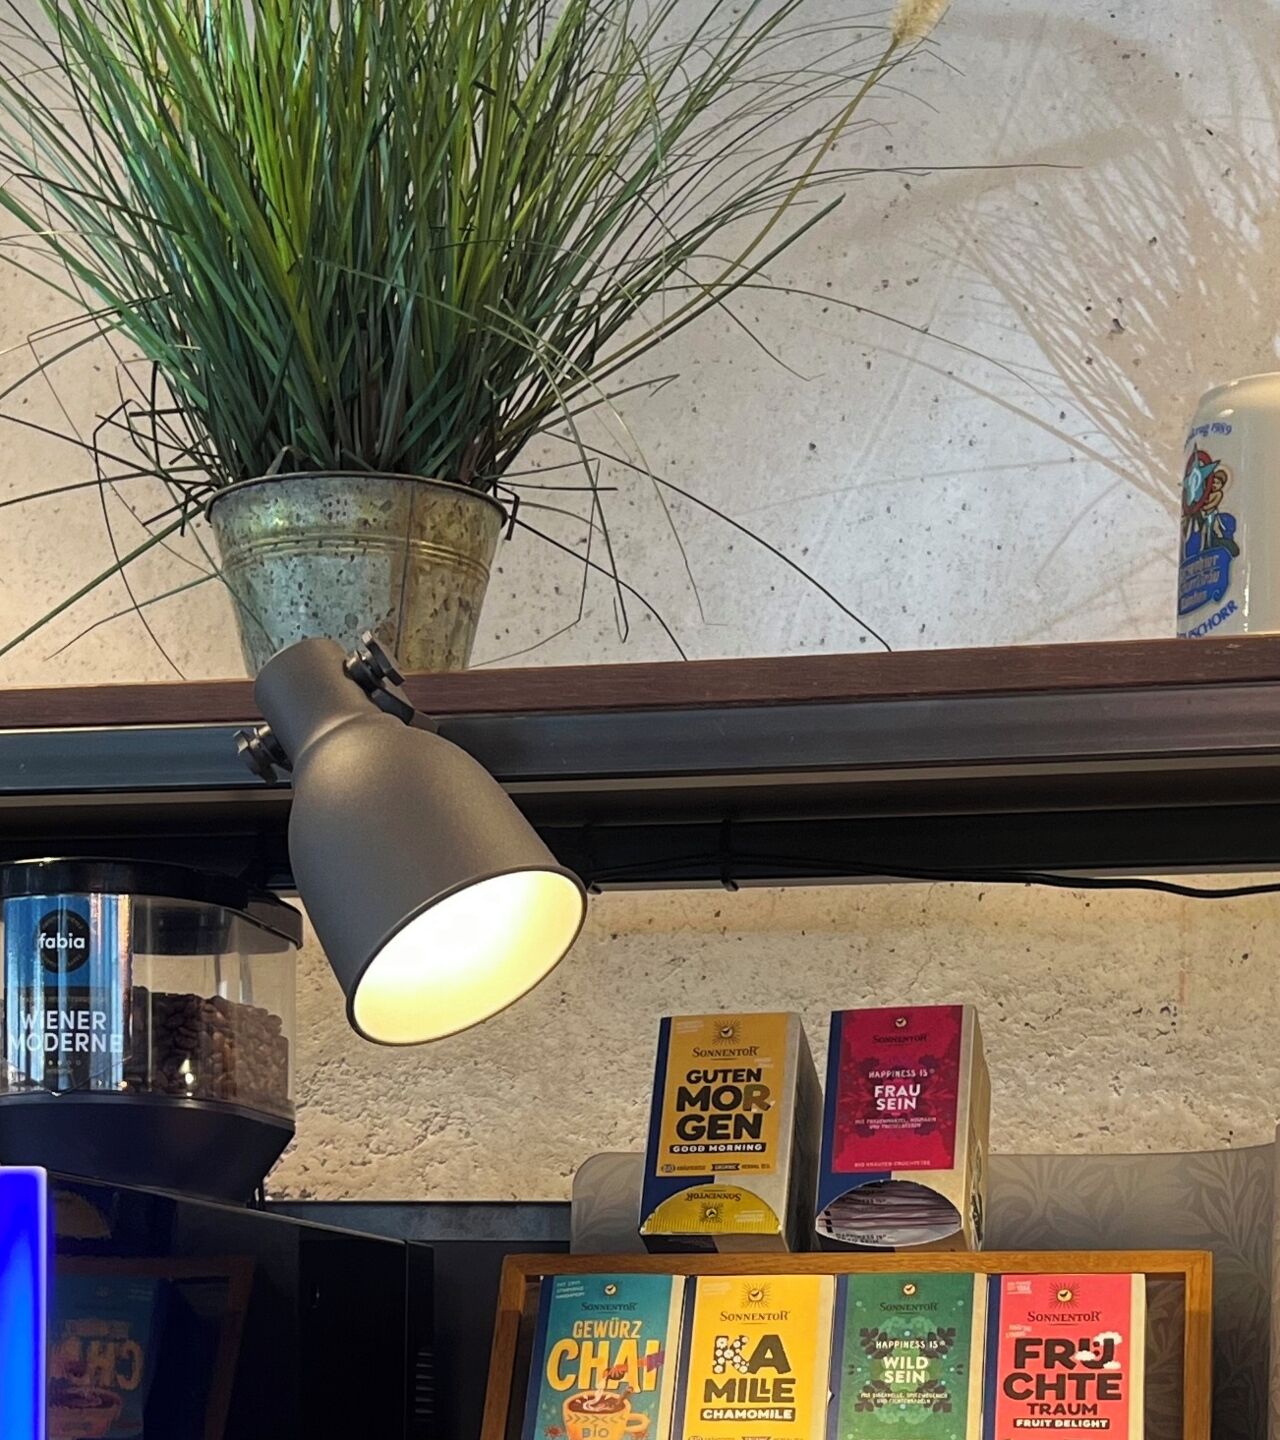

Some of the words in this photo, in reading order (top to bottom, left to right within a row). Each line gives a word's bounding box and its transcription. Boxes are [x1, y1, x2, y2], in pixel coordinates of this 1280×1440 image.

[38, 932, 86, 950] fabia
[20, 1010, 107, 1031] WIENER
[7, 1032, 124, 1053] MODERNE
[686, 1067, 763, 1085] GUTEN
[676, 1083, 773, 1113] MOR
[874, 1083, 921, 1099] FRAU
[876, 1097, 917, 1112] SEIN
[676, 1112, 764, 1141] GEN
[672, 1144, 706, 1153] GOOD
[708, 1143, 763, 1152] MORNING
[720, 1310, 792, 1323] SONNENTOR
[1027, 1310, 1102, 1322] SONNENTOR
[572, 1316, 643, 1339] GEWÜRZ
[875, 1340, 926, 1350] HAPPINESS
[713, 1334, 793, 1375] KA
[883, 1356, 929, 1370] WILD
[546, 1338, 664, 1393] CHAI
[883, 1370, 926, 1384] SEIN
[703, 1378, 796, 1404] MILLE
[1003, 1372, 1123, 1401] CHTE
[702, 1408, 794, 1420] CHAMOMILE
[1026, 1402, 1098, 1416] TRAUM
[1015, 1419, 1053, 1428] FRUIT
[1054, 1419, 1109, 1429] DELIGHT
